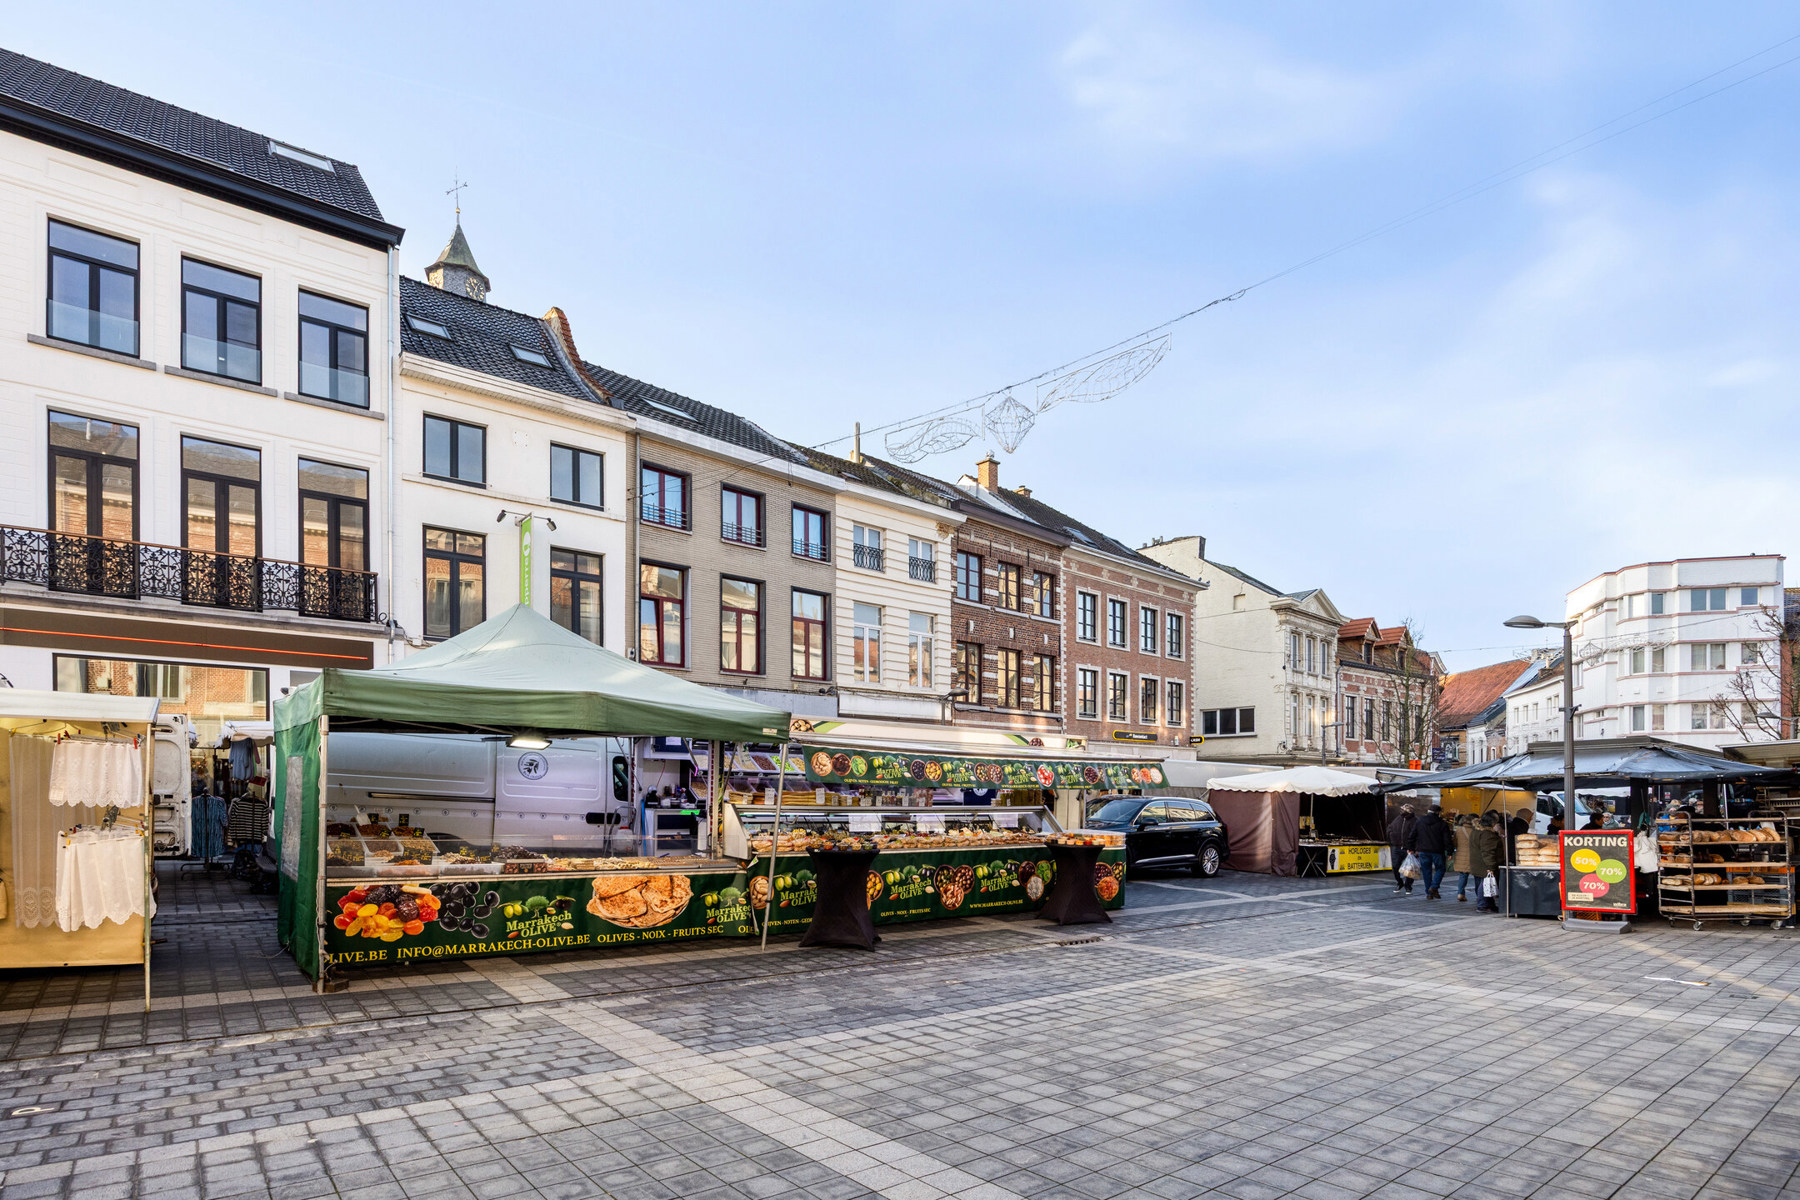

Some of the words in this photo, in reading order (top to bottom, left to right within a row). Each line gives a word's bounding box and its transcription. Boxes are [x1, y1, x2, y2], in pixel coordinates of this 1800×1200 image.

[1564, 836, 1627, 847] KORTING
[1575, 857, 1597, 866] 50%
[1600, 867, 1622, 876] 70%
[890, 877, 932, 894] Marrakech
[981, 872, 1018, 887] Marrakech
[1583, 881, 1605, 890] 70%
[899, 887, 923, 899] OLIVE
[988, 882, 1009, 892] OLIVE
[706, 903, 752, 918] Marrakec
[506, 910, 572, 932] Marrakech
[716, 912, 747, 923] OLIVE
[521, 922, 557, 938] OLIVE
[397, 934, 591, 959] INFO@MARRAKECH-OLIVE.BE
[597, 932, 635, 944] OLIVES
[642, 929, 666, 940] NOIX
[673, 926, 706, 938] FRUITS
[707, 925, 724, 935] SEC
